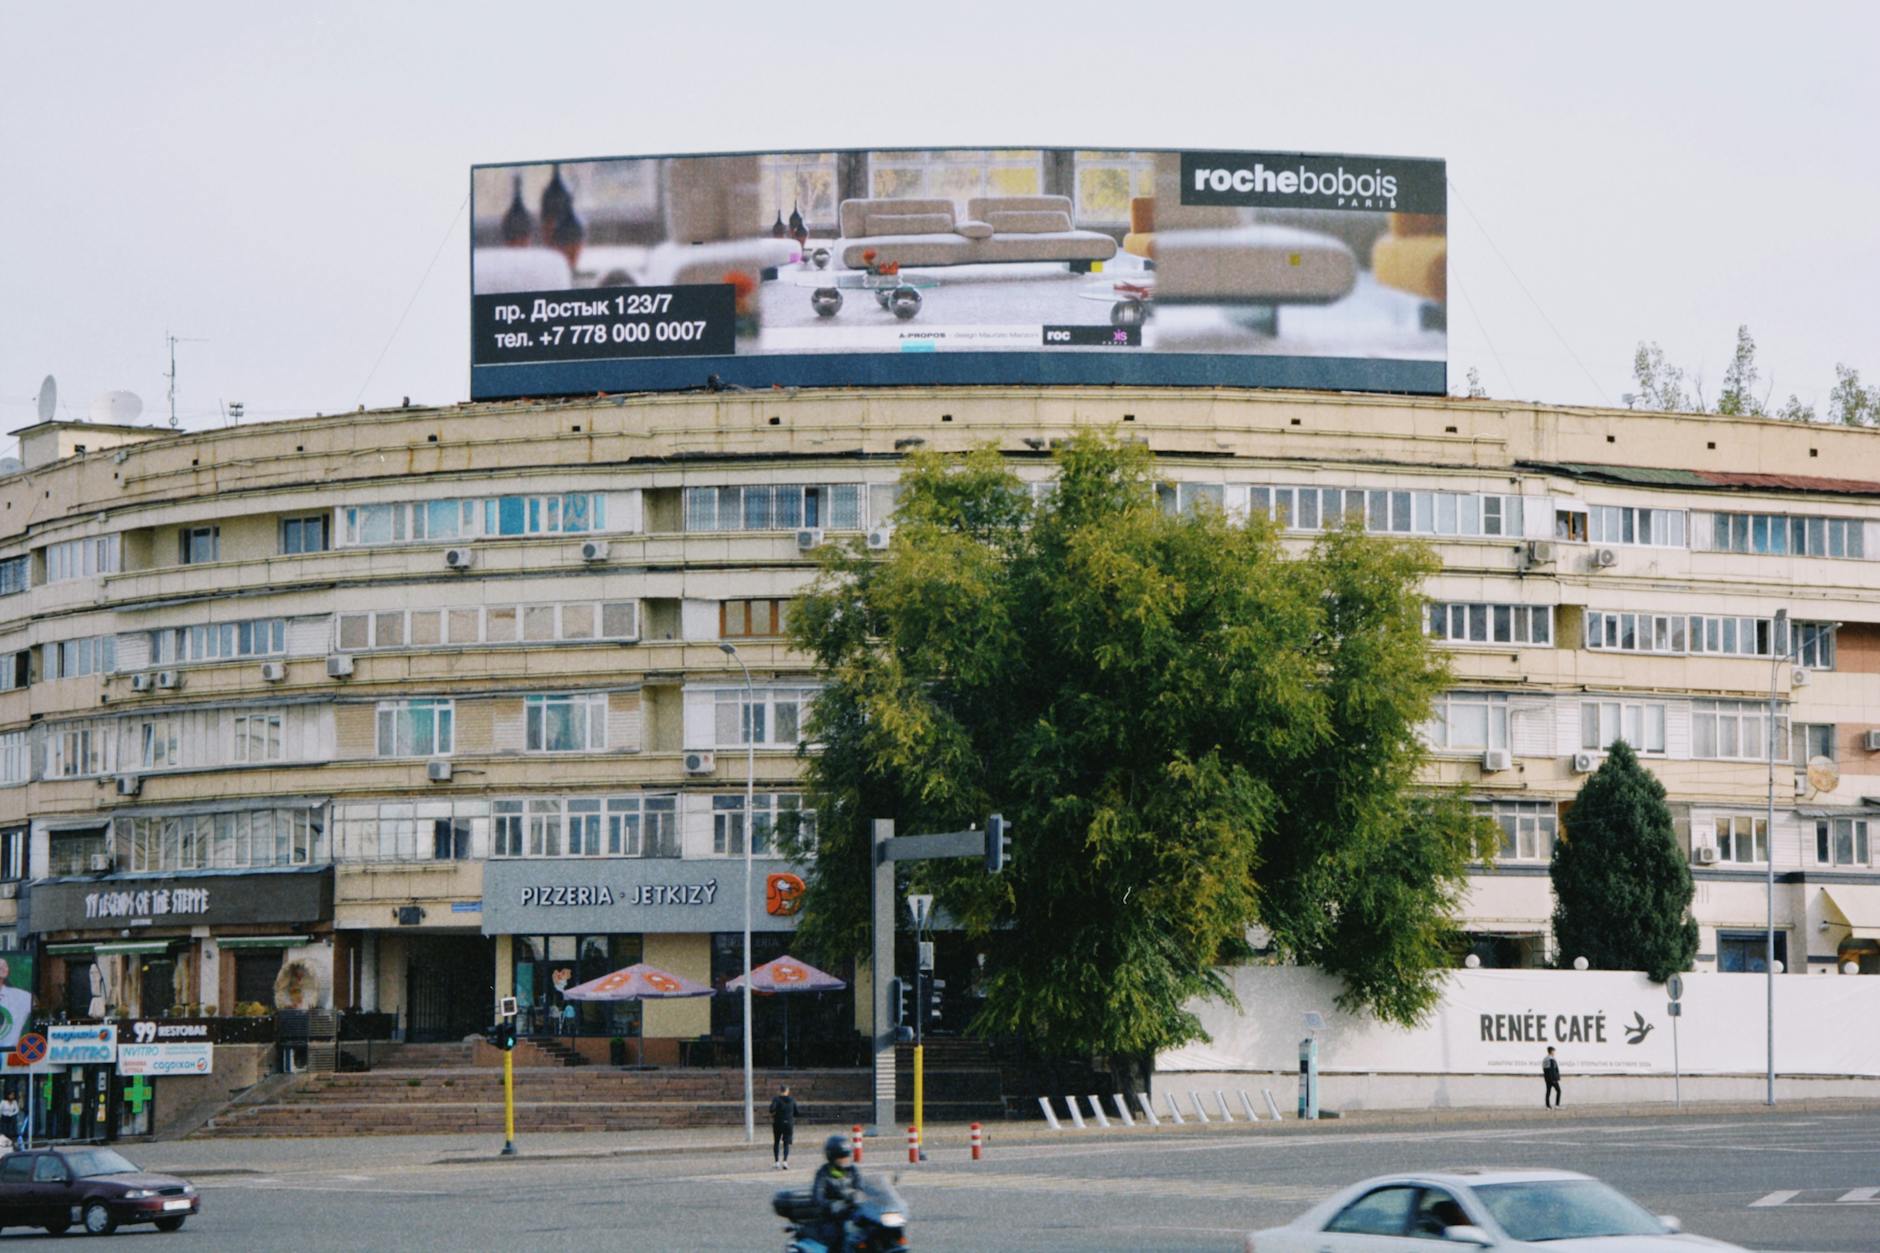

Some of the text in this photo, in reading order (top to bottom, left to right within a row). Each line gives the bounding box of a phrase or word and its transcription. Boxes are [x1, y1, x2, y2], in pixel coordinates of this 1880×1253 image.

[1194, 163, 1398, 198] rochebobois
[1338, 198, 1397, 209] PARIS
[494, 294, 673, 324] пр. Достык 123/7
[494, 320, 706, 348] тел. +7 778 000 0007
[172, 888, 210, 914] STEPPE
[521, 878, 717, 906] PIZZERIA JETKIZÝ
[133, 1021, 157, 1043] 99
[1480, 1009, 1607, 1043] RENÉE CAFÉ
